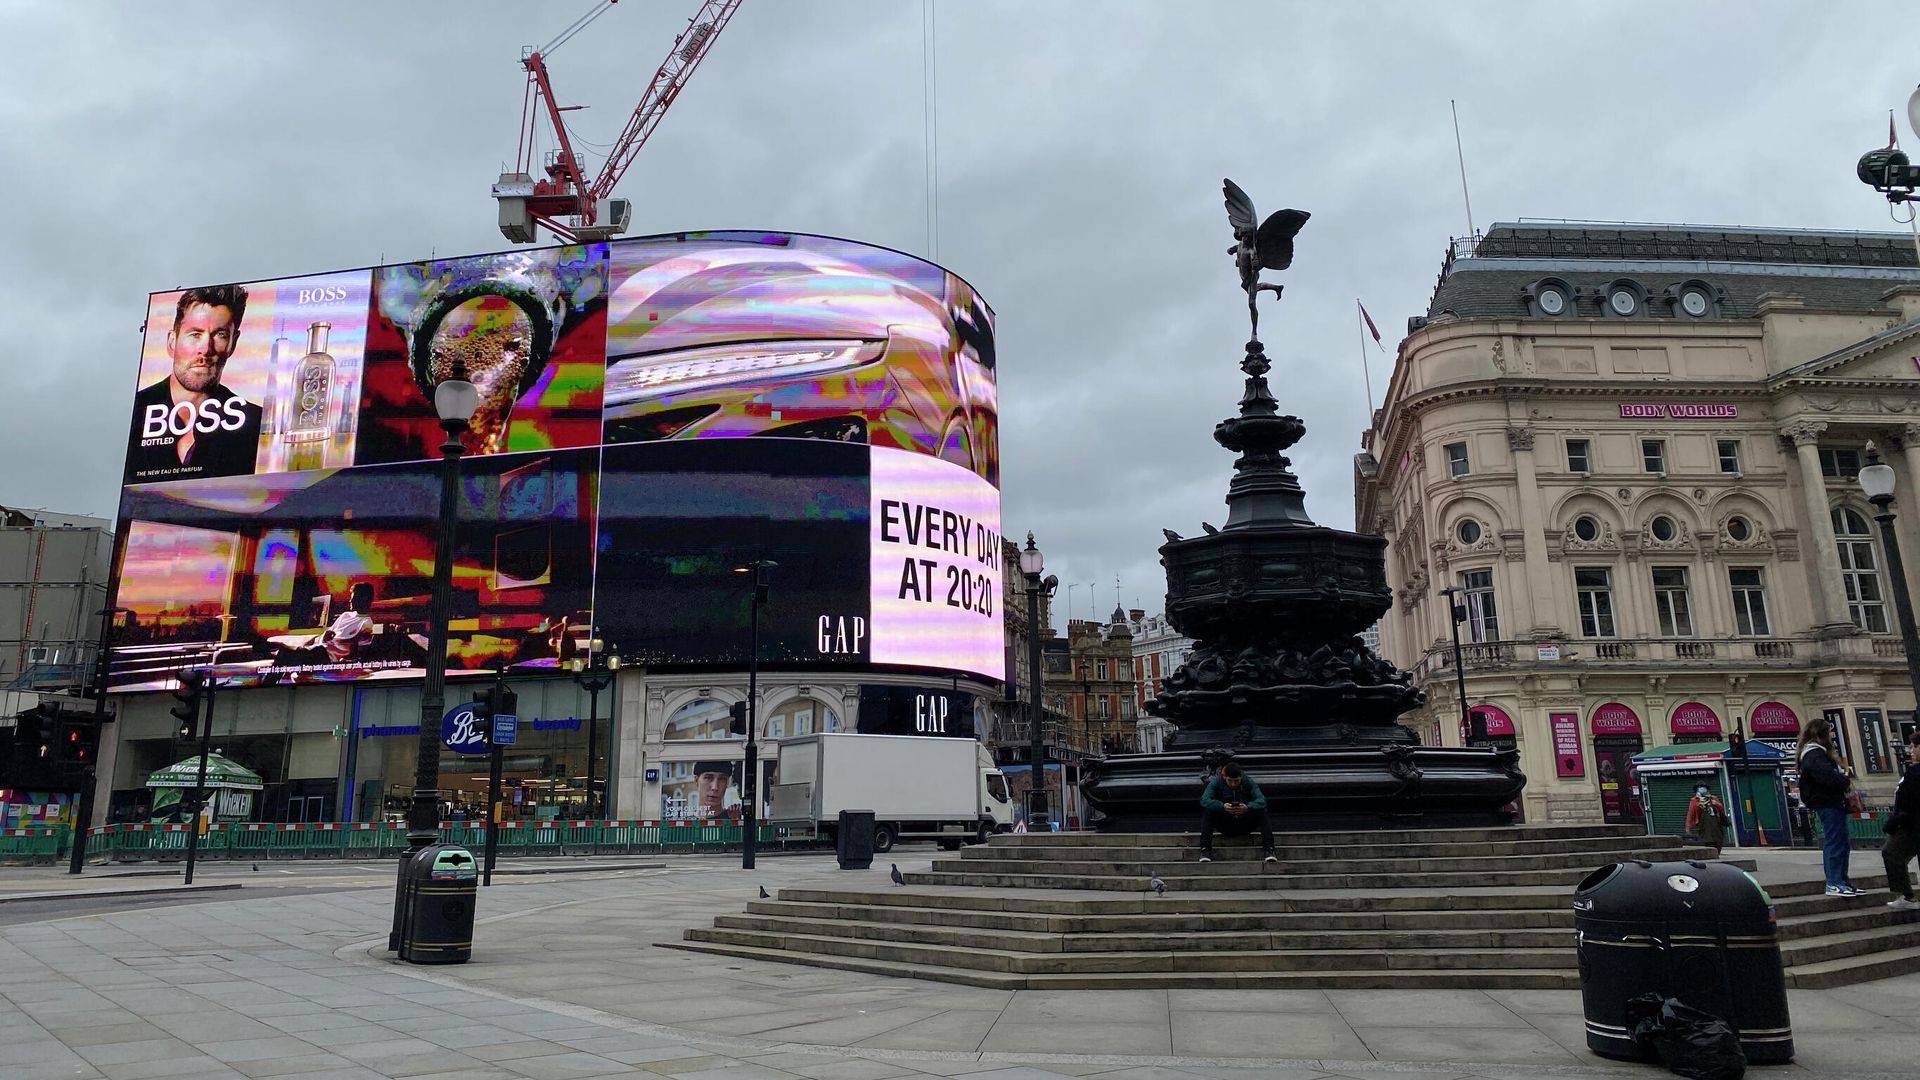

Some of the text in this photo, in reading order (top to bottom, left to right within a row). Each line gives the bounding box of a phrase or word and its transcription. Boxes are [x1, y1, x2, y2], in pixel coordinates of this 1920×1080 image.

[298, 286, 347, 304] BOSS
[143, 396, 247, 438] BOSS
[1620, 404, 1738, 418] BODY WORLDS
[141, 437, 175, 447] BOTTLED
[881, 499, 999, 571] EVERY DAY
[898, 557, 992, 618] AT 20:20
[818, 614, 865, 654] GAP
[916, 694, 948, 733] GAP
[1862, 717, 1878, 771] TOBACCO
